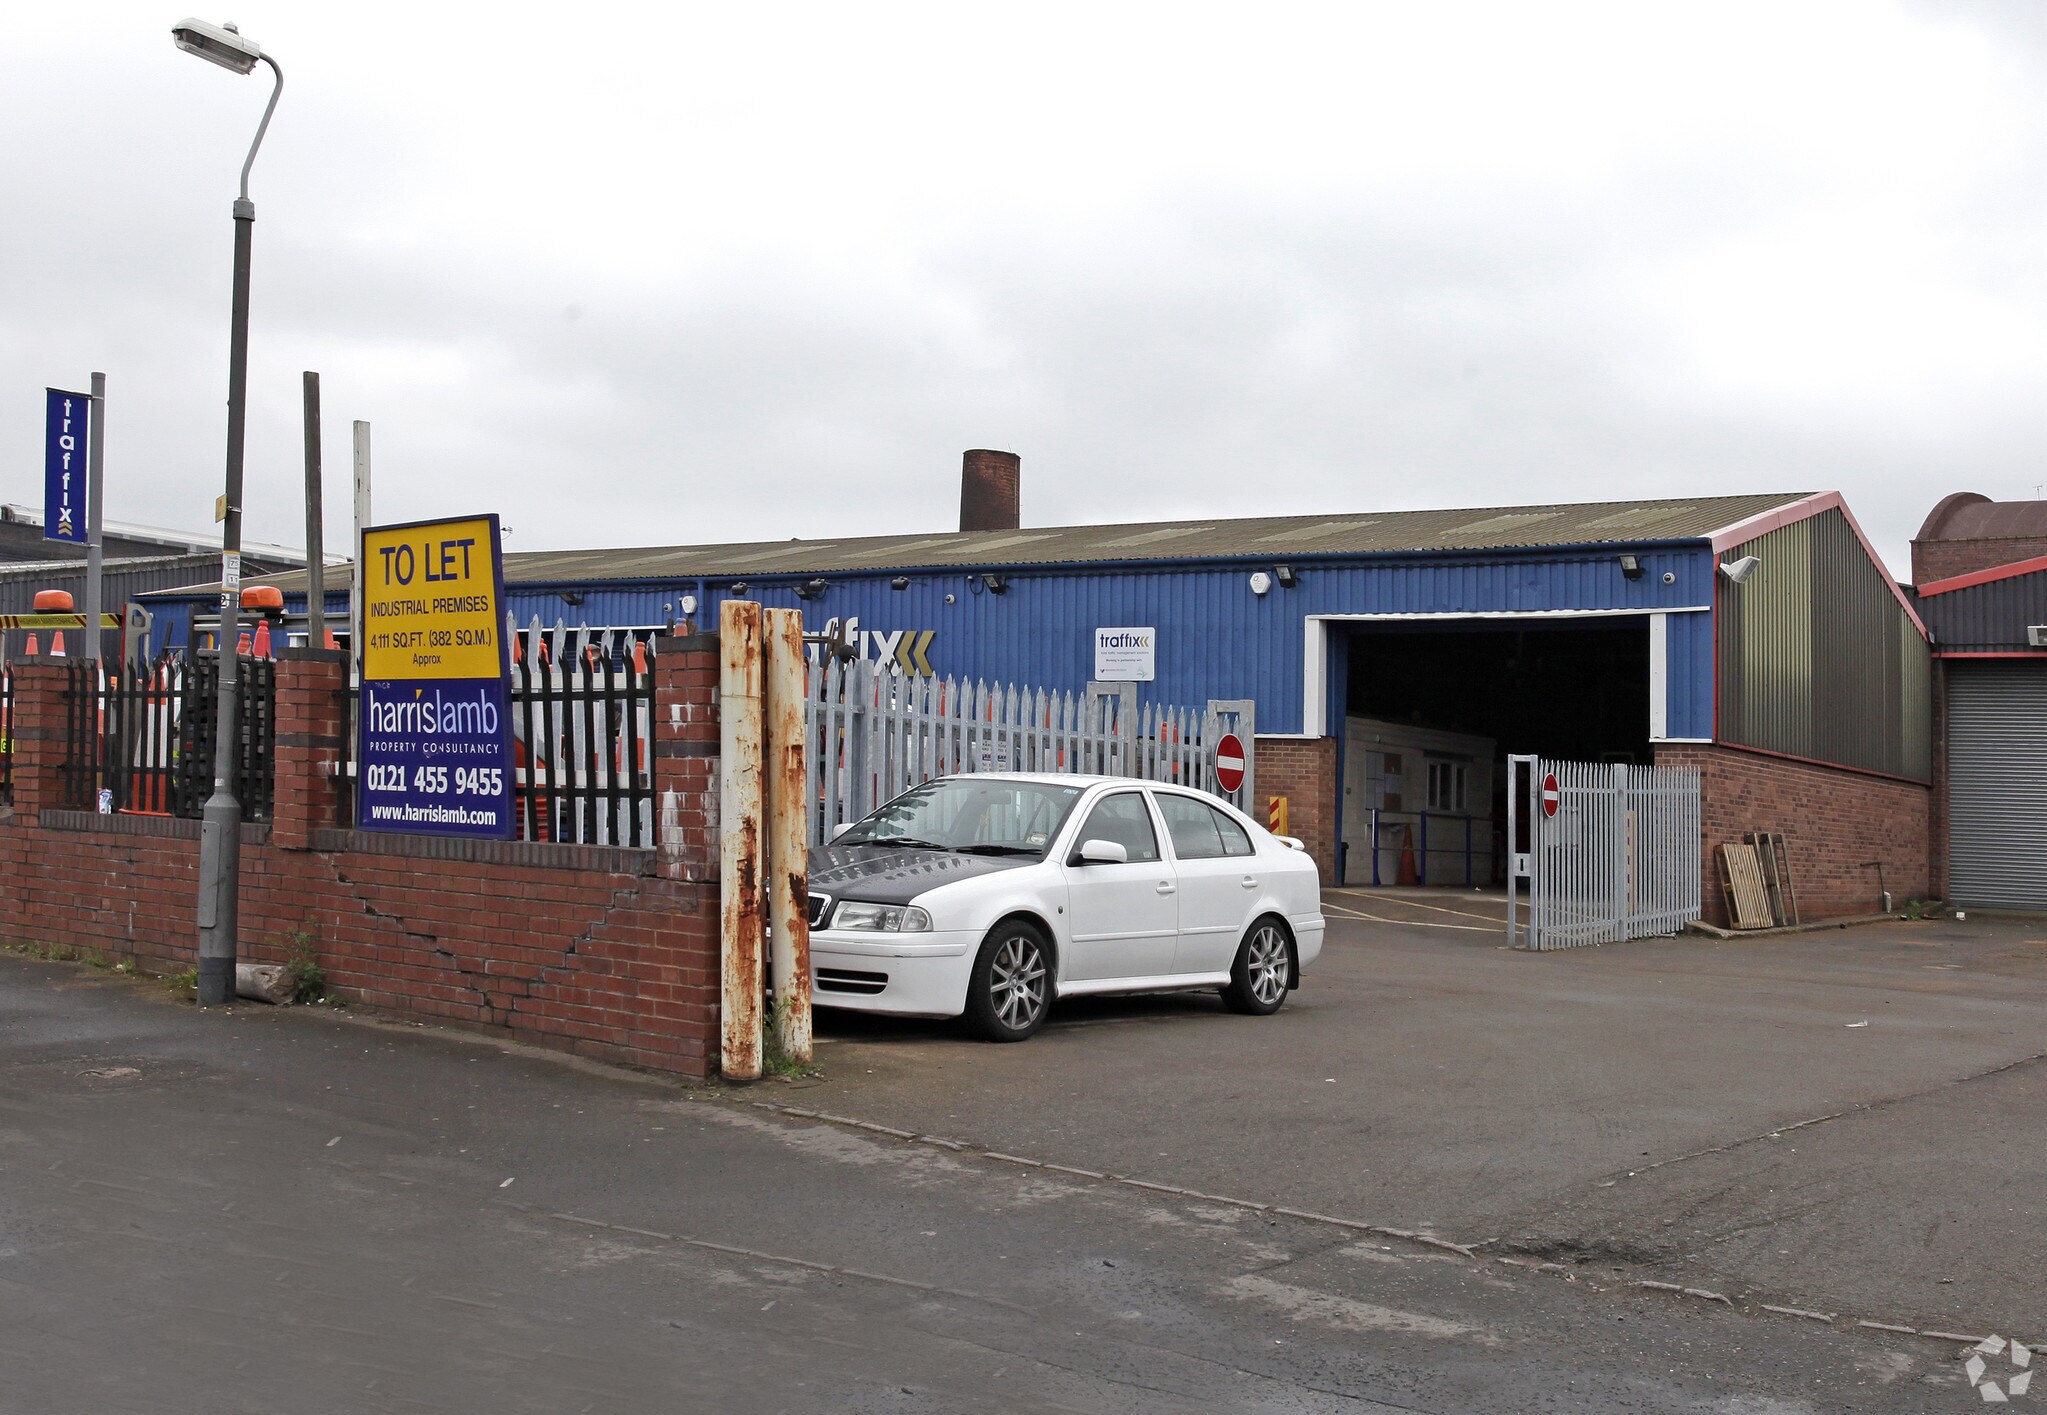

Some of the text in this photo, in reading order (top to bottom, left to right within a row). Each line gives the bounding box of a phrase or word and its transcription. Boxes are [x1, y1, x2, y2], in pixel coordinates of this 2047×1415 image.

[59, 399, 75, 523] traffix
[379, 538, 475, 586] TO LET
[371, 595, 489, 618] INDUSTRIAL PREMISES
[370, 627, 492, 651] 4,111 SQ.FT. (382 SQ.M.)
[1100, 633, 1140, 648] traffix
[412, 653, 442, 667] Approx
[369, 688, 498, 734] harrislamb
[369, 741, 499, 754] PROPERTY CONSULTANCY
[367, 764, 503, 796] 0121 455 9455
[371, 803, 497, 826] www.harrislamb.com
